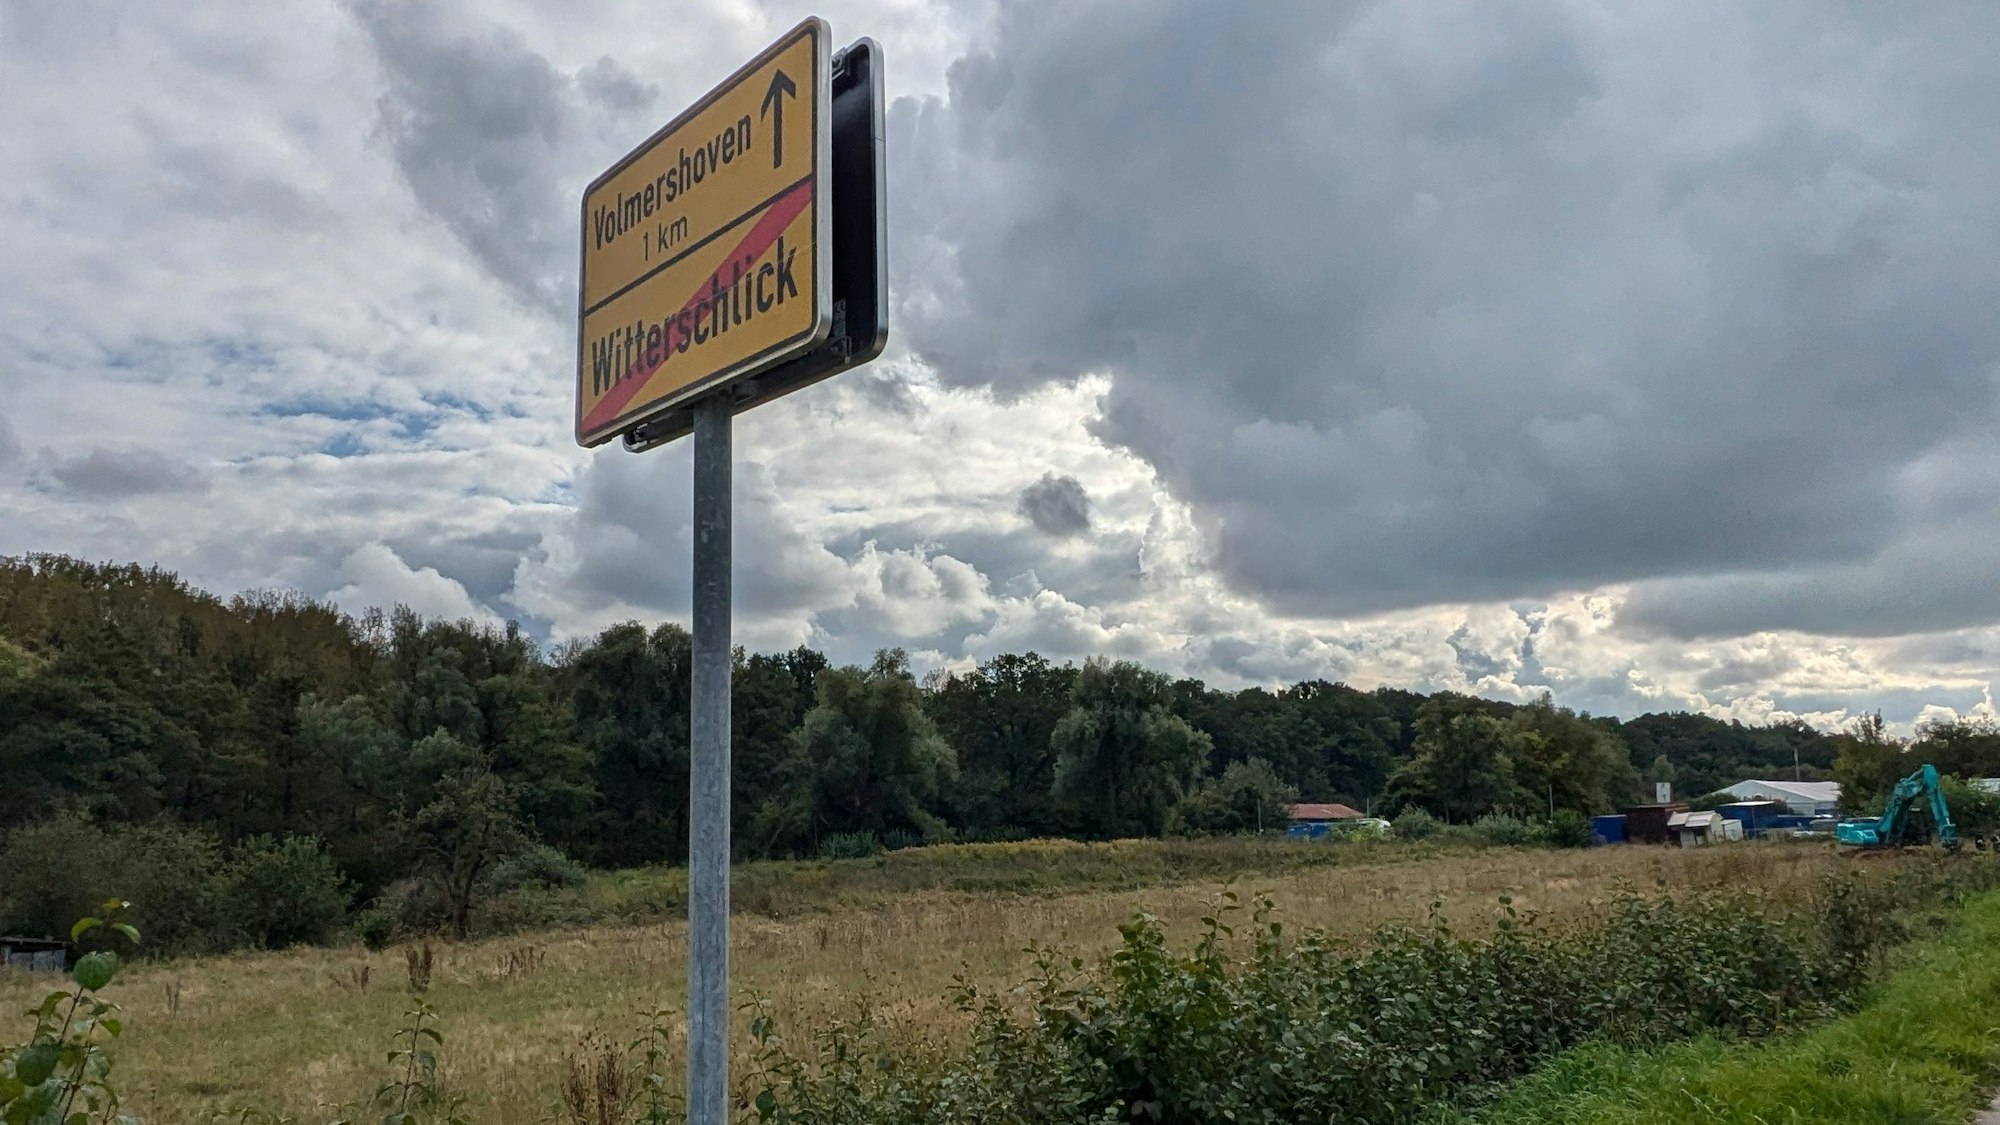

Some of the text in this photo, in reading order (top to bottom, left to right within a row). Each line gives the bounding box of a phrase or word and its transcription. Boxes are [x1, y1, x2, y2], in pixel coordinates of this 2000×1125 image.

[594, 114, 751, 250] Volmershoven
[643, 214, 688, 262] 1 km
[592, 235, 798, 397] Witterschlick
